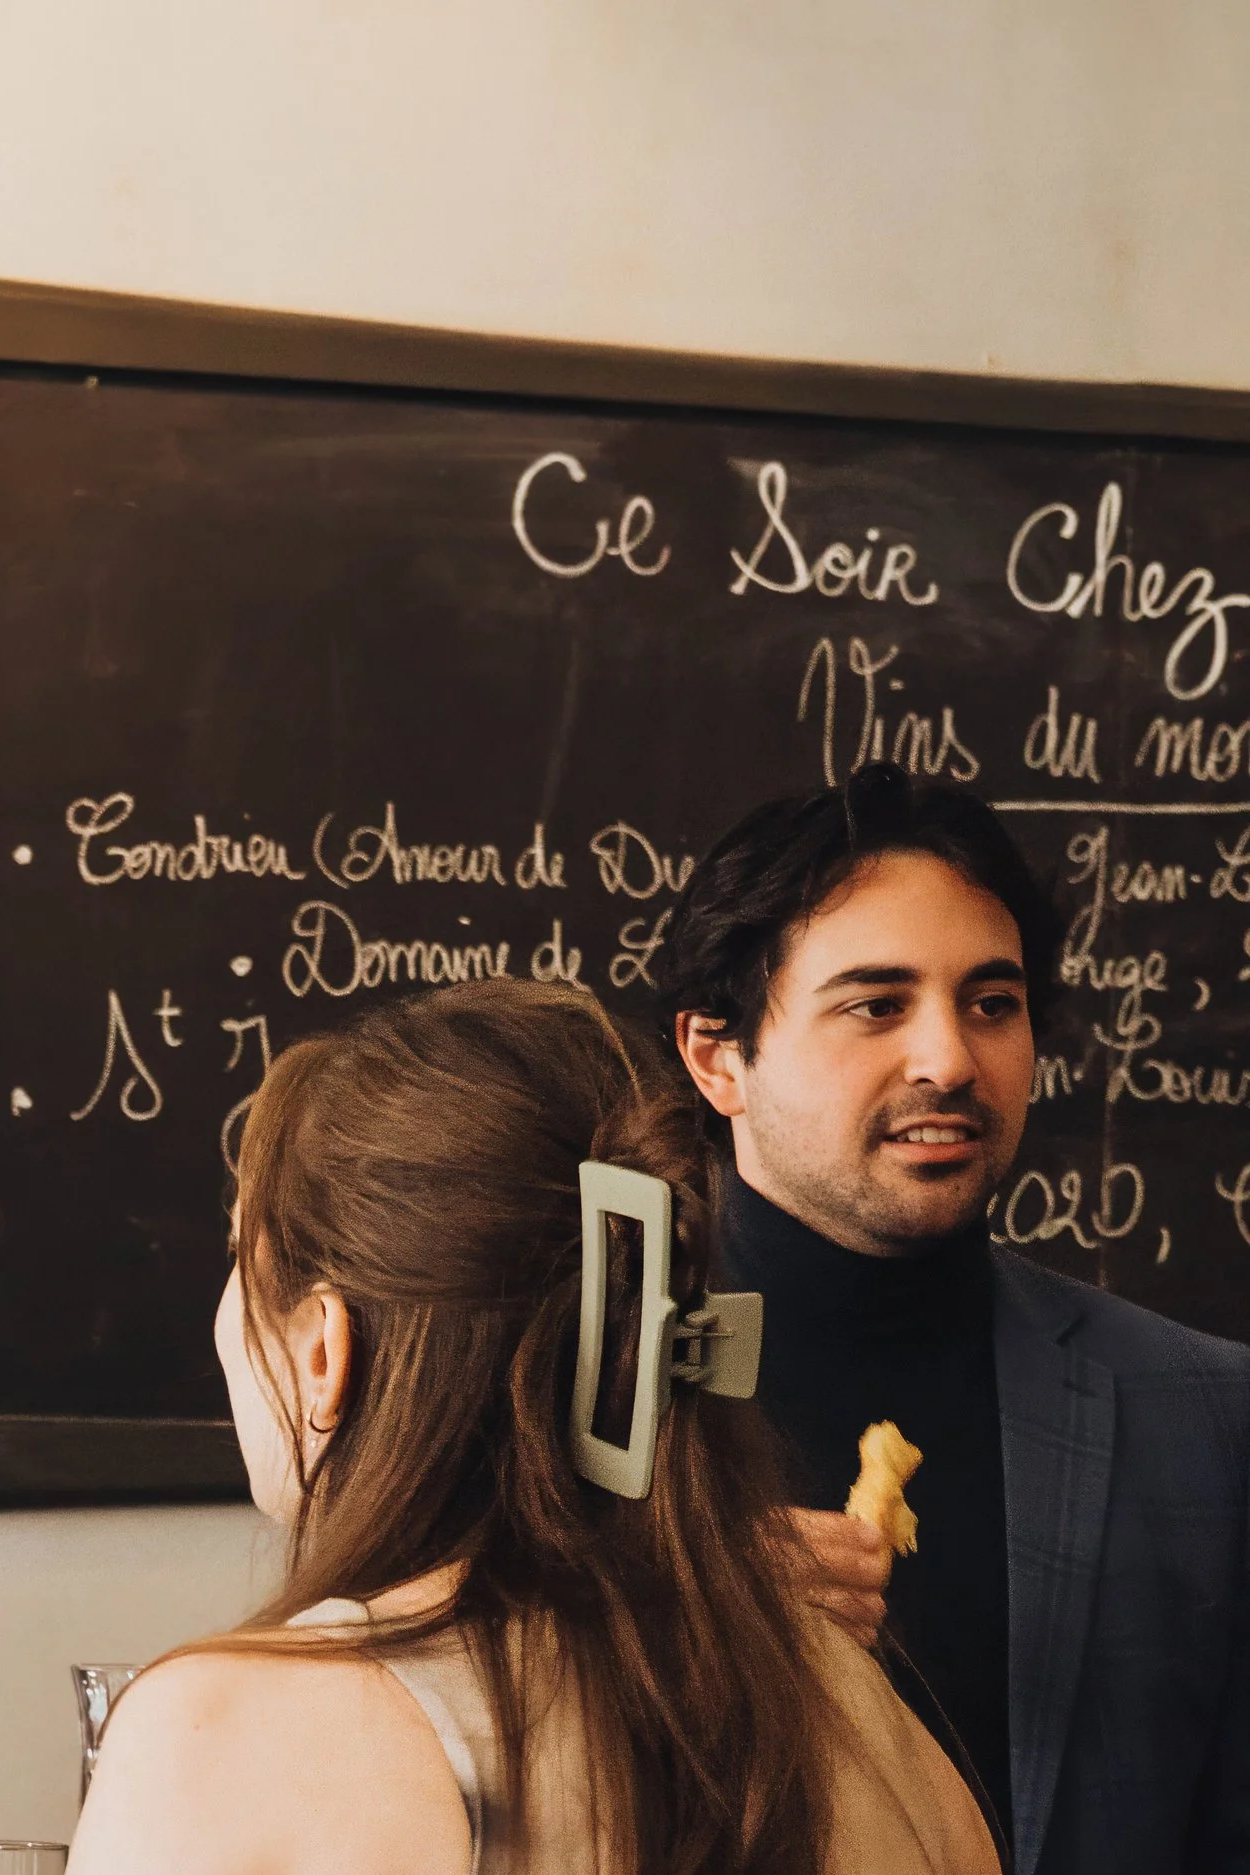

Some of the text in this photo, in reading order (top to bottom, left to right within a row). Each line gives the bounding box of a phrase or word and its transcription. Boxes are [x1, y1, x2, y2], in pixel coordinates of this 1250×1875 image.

[512, 452, 670, 578] Ce
[1007, 482, 1250, 701] Chez
[797, 636, 981, 786] Vins
[1024, 686, 1102, 783] du
[281, 899, 511, 998] Domaine
[530, 917, 593, 992] de
[514, 820, 569, 890] de
[1061, 823, 1250, 955] Jean-L
